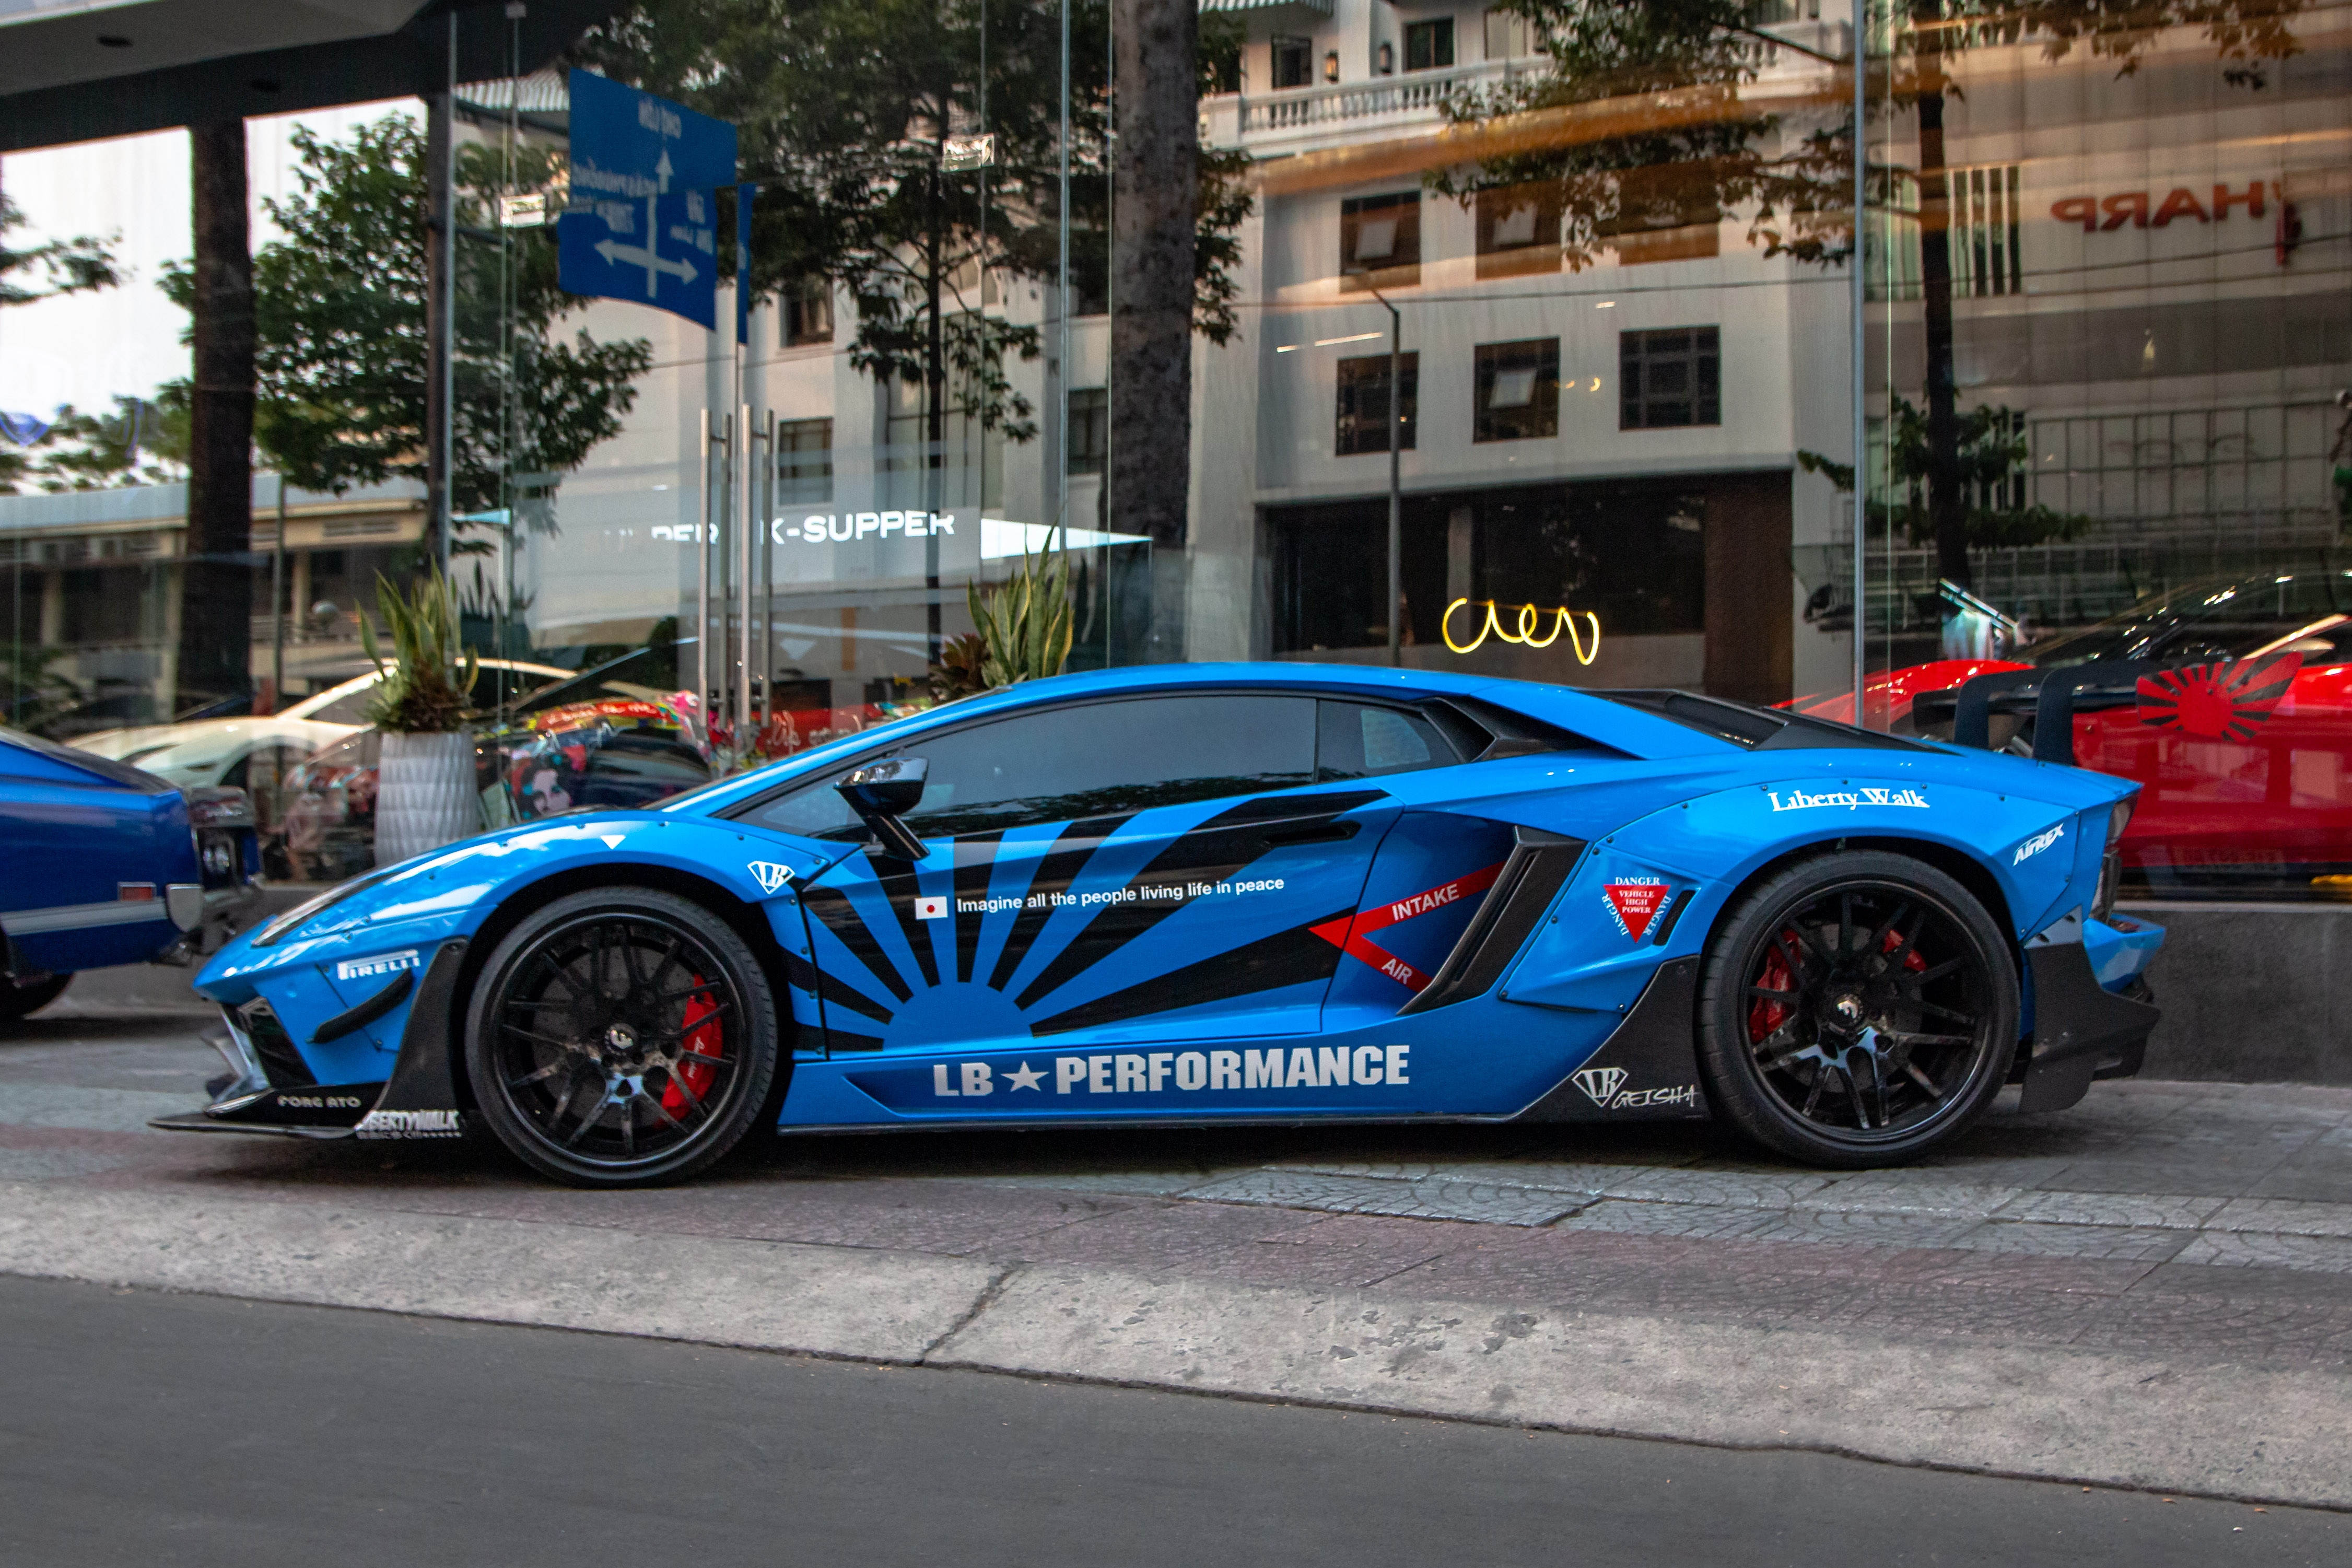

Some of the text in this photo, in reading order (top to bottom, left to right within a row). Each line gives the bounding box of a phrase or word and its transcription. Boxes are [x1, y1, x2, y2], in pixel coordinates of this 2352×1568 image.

[1768, 788, 1930, 811] Liberty Walk
[957, 879, 1284, 913] Imagine all the people living life in peace
[1615, 877, 1660, 885] DANGER
[1391, 883, 1460, 921] INTAKE
[1602, 894, 1629, 936] DANGER
[1643, 895, 1672, 935] DANGER
[337, 949, 420, 980] PIRELLI
[1382, 958, 1413, 985] AIR
[933, 1045, 1410, 1097] LB PERFORMANCE
